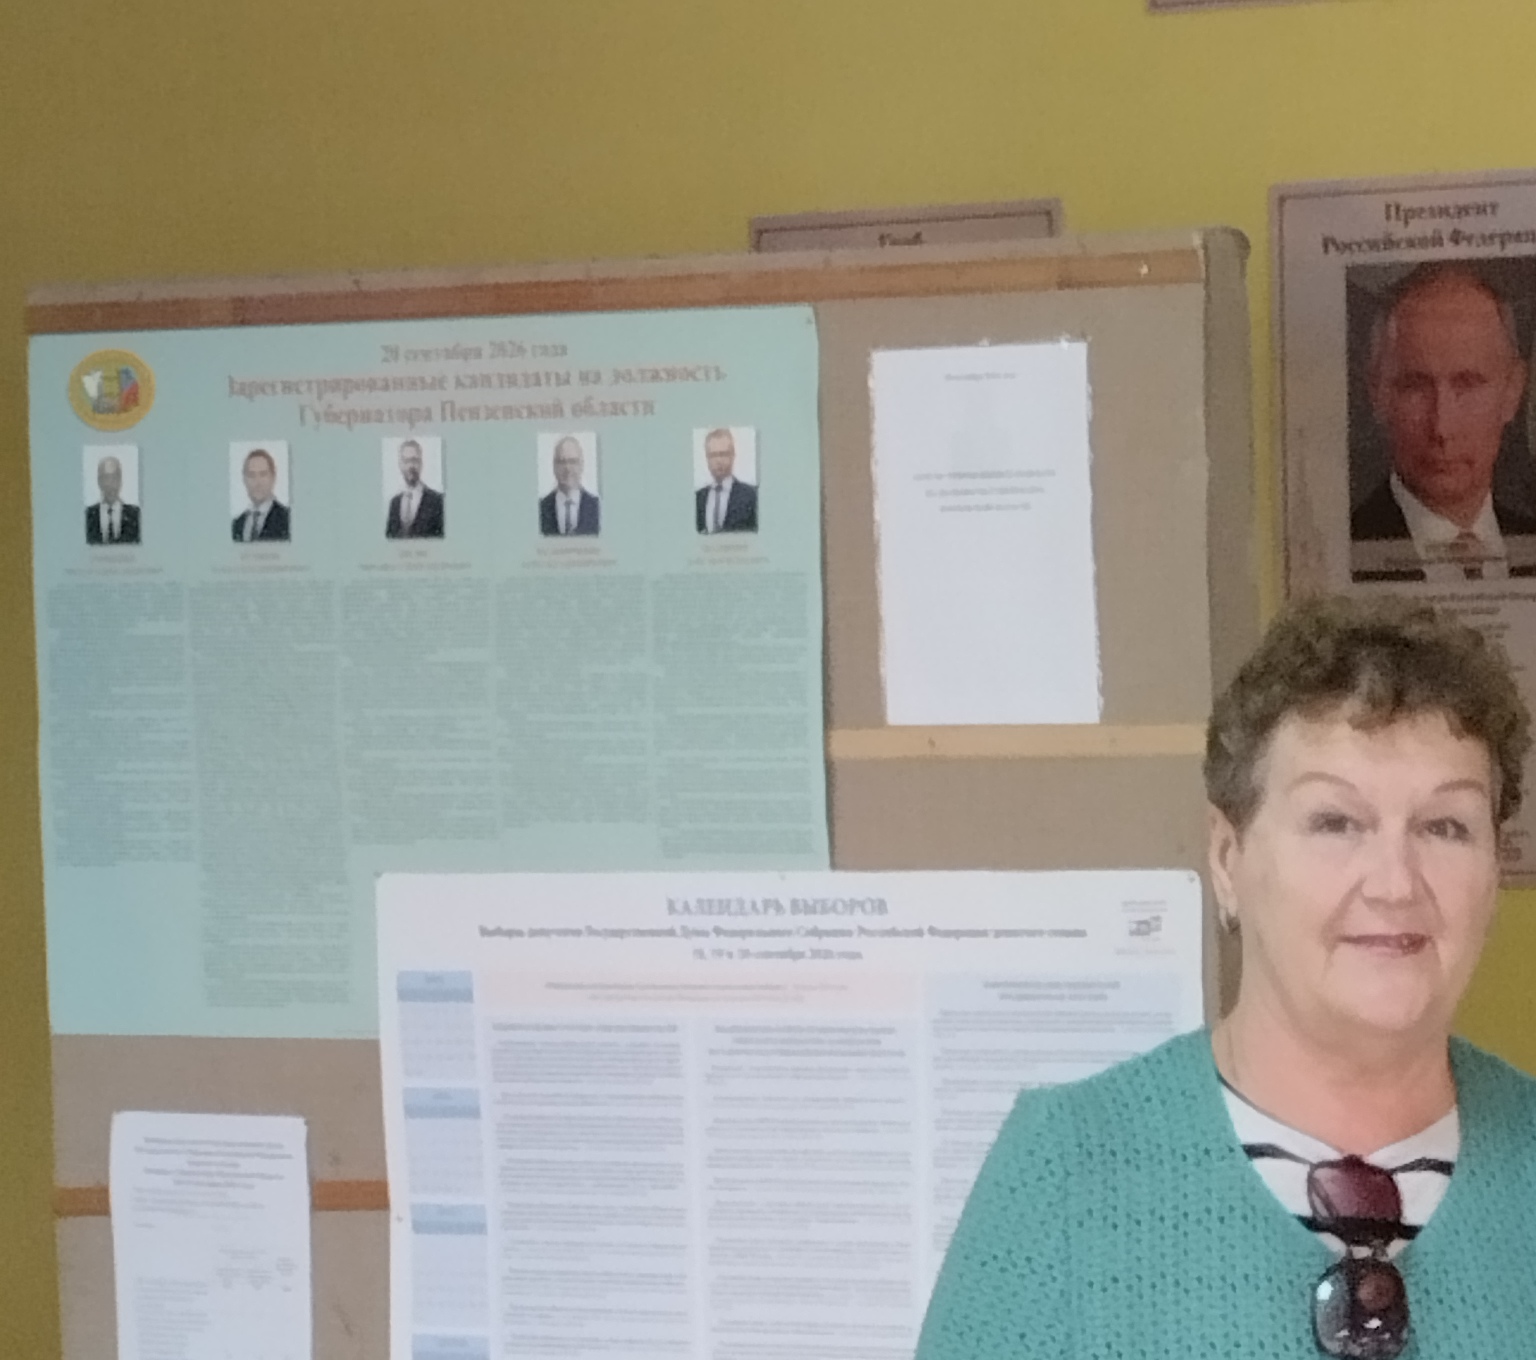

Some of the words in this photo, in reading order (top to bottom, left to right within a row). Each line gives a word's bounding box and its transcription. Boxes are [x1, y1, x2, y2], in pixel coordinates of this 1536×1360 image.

[1384, 201, 1500, 228] Президент
[1321, 231, 1445, 255] Российской
[453, 368, 572, 392] кандидаты
[299, 402, 433, 430] Губернатора
[570, 397, 656, 419] области
[666, 897, 786, 916] КАЛЕНДАРЬ
[789, 897, 889, 916] ВЫБОРОВ
